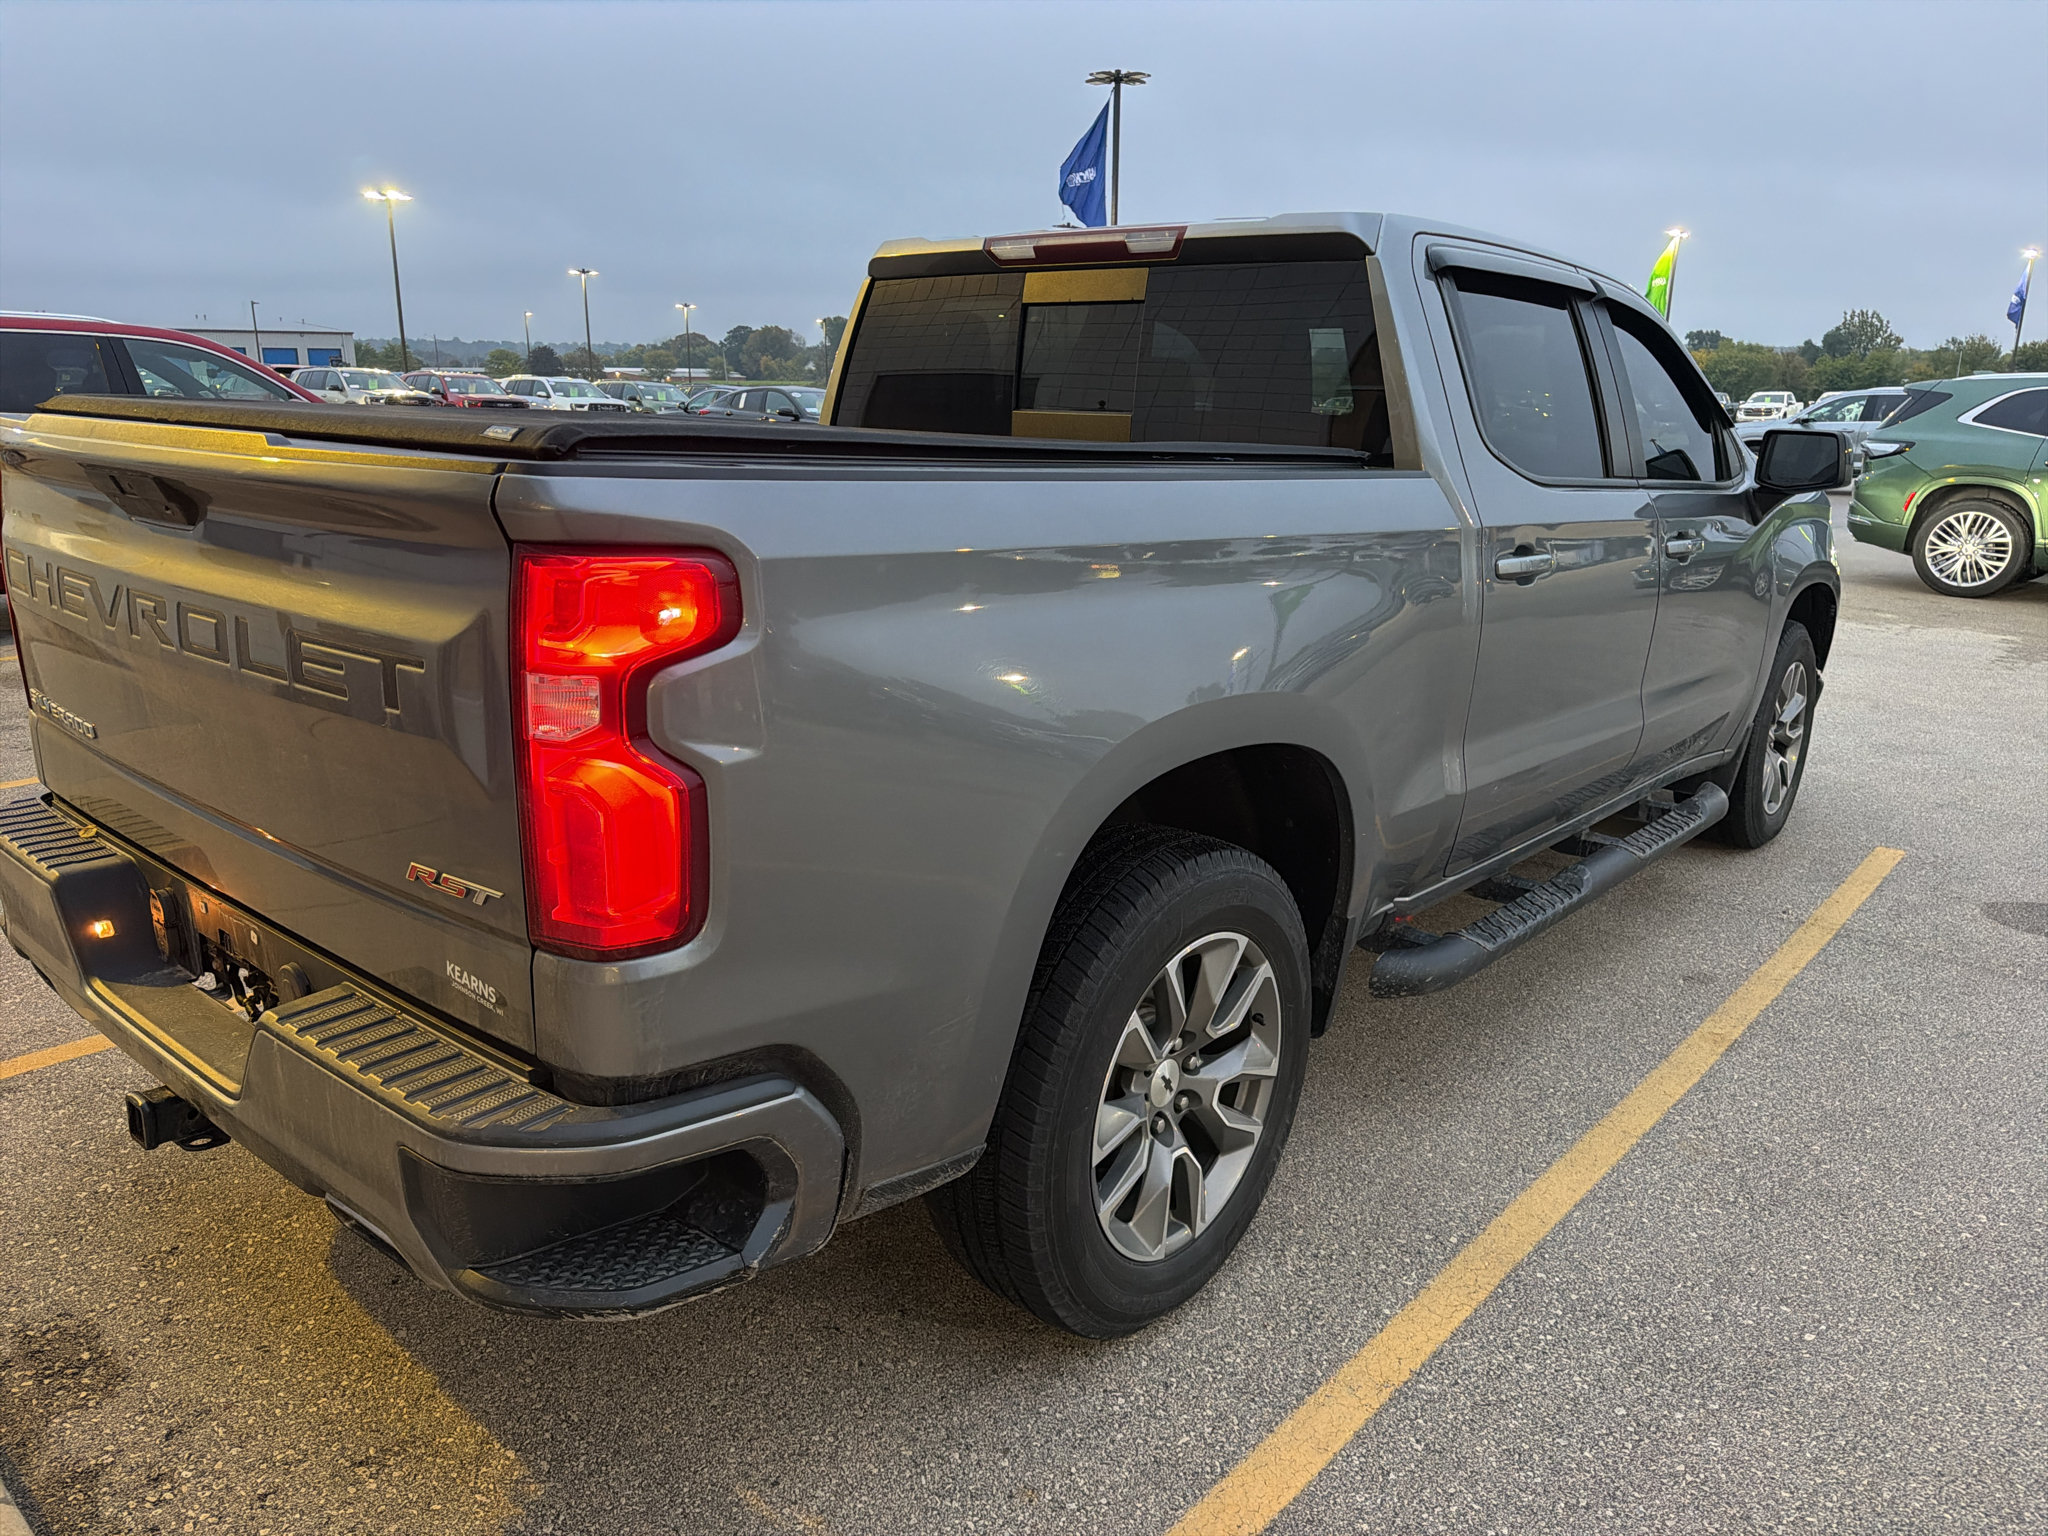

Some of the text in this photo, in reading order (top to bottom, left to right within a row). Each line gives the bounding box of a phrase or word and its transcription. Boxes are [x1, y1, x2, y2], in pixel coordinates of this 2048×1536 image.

[6, 547, 425, 714] CHEVROLET
[29, 687, 97, 739] SILVERADO
[406, 862, 504, 906] RST
[446, 960, 497, 1004] KEARNS
[451, 981, 504, 1017] JOHNSON CREEK, WI
